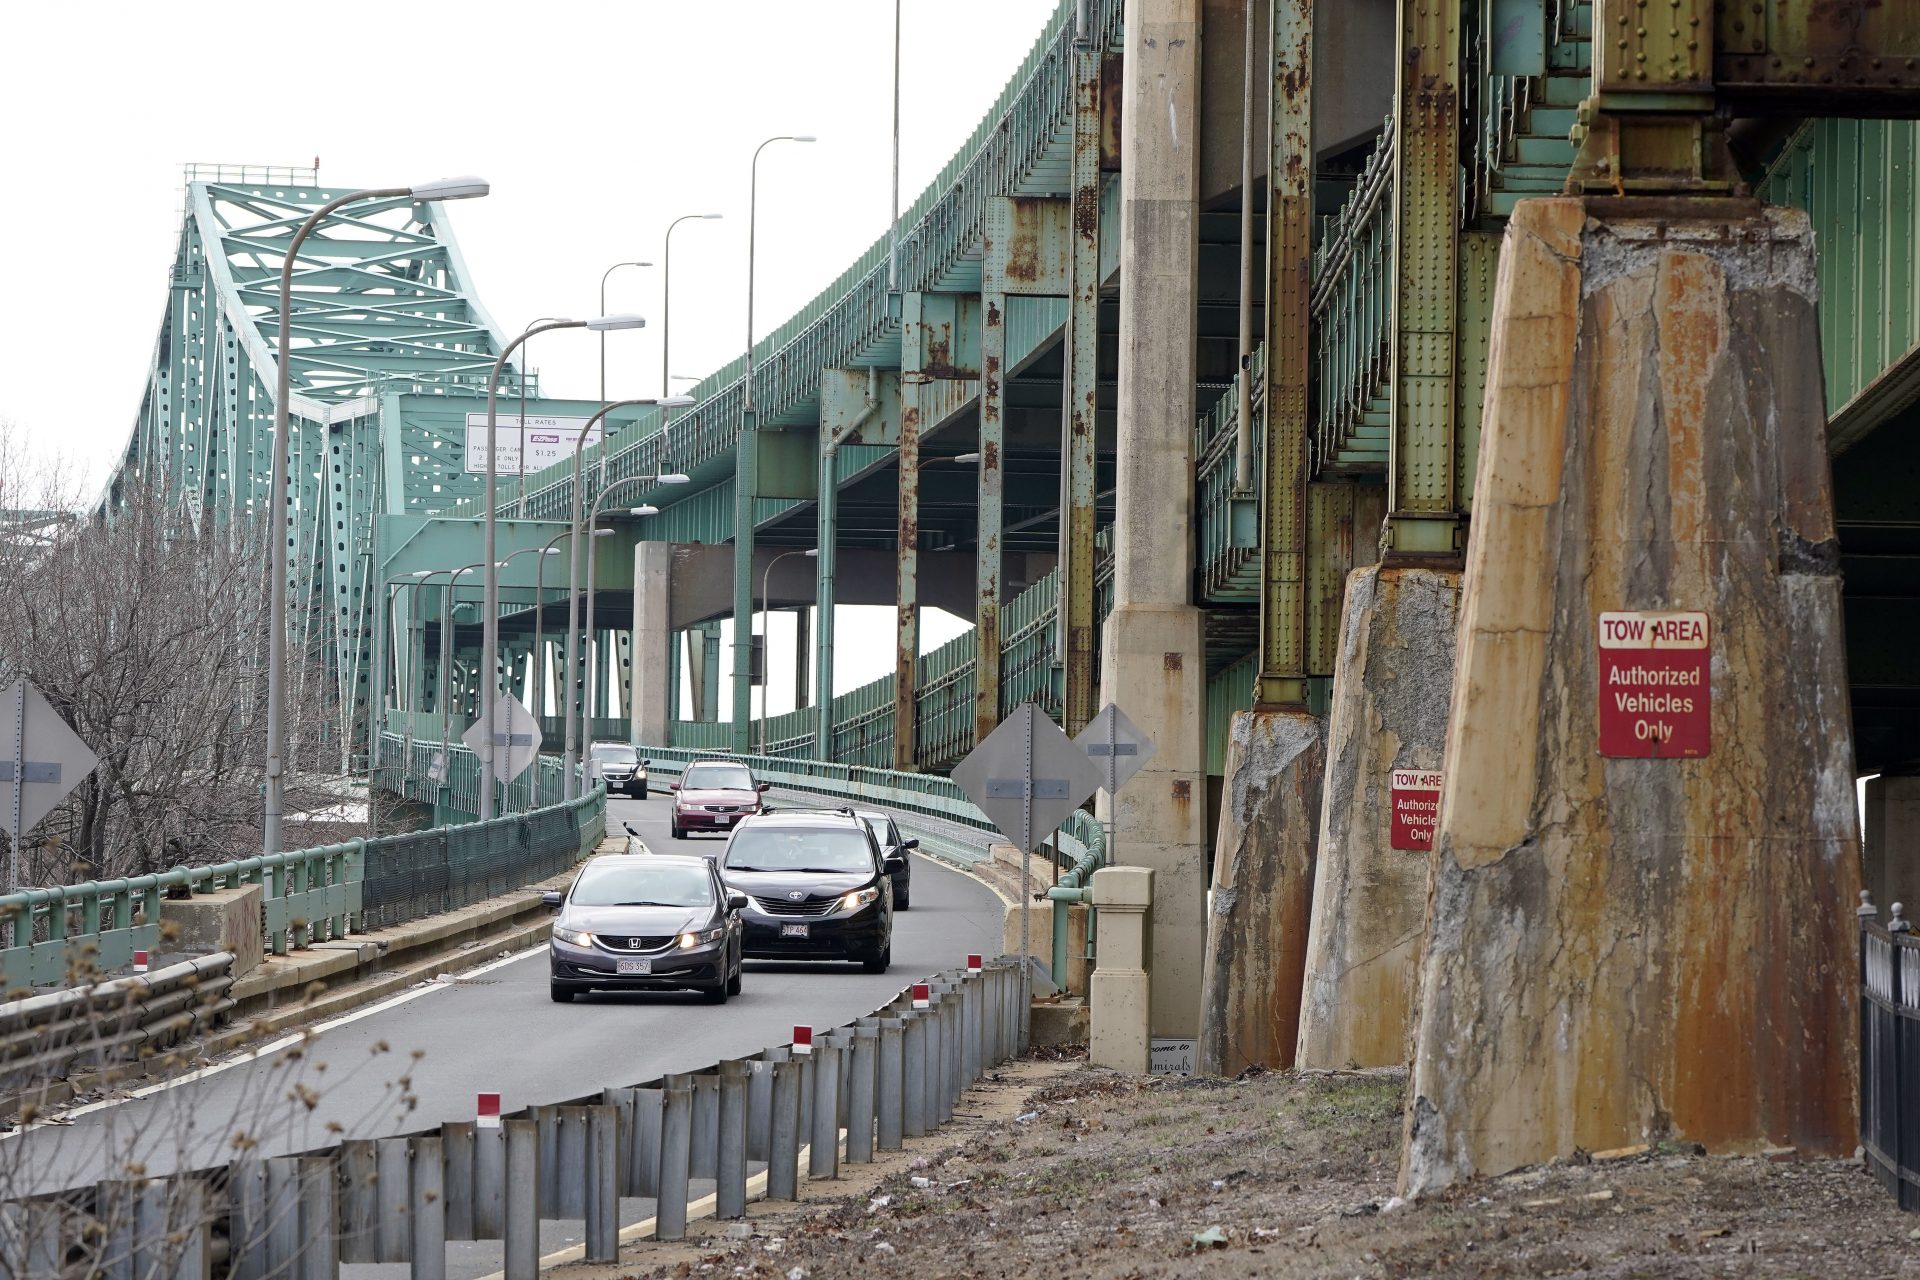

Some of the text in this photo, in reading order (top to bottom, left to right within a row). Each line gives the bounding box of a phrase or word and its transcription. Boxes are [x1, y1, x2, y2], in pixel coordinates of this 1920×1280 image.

[535, 449, 557, 457] $1.25
[1603, 620, 1703, 641] TOW AREA
[1608, 665, 1700, 686] Authorized
[1615, 692, 1693, 713] Vehicles
[1634, 719, 1673, 744] Only
[1395, 774, 1442, 786] TOW ARE
[1397, 798, 1440, 811] Authorize
[1400, 813, 1437, 826] Vehicle
[1411, 829, 1432, 842] Only
[620, 961, 649, 971] 6DS 357
[1179, 1043, 1190, 1051] to
[1150, 1055, 1191, 1071] mirals
